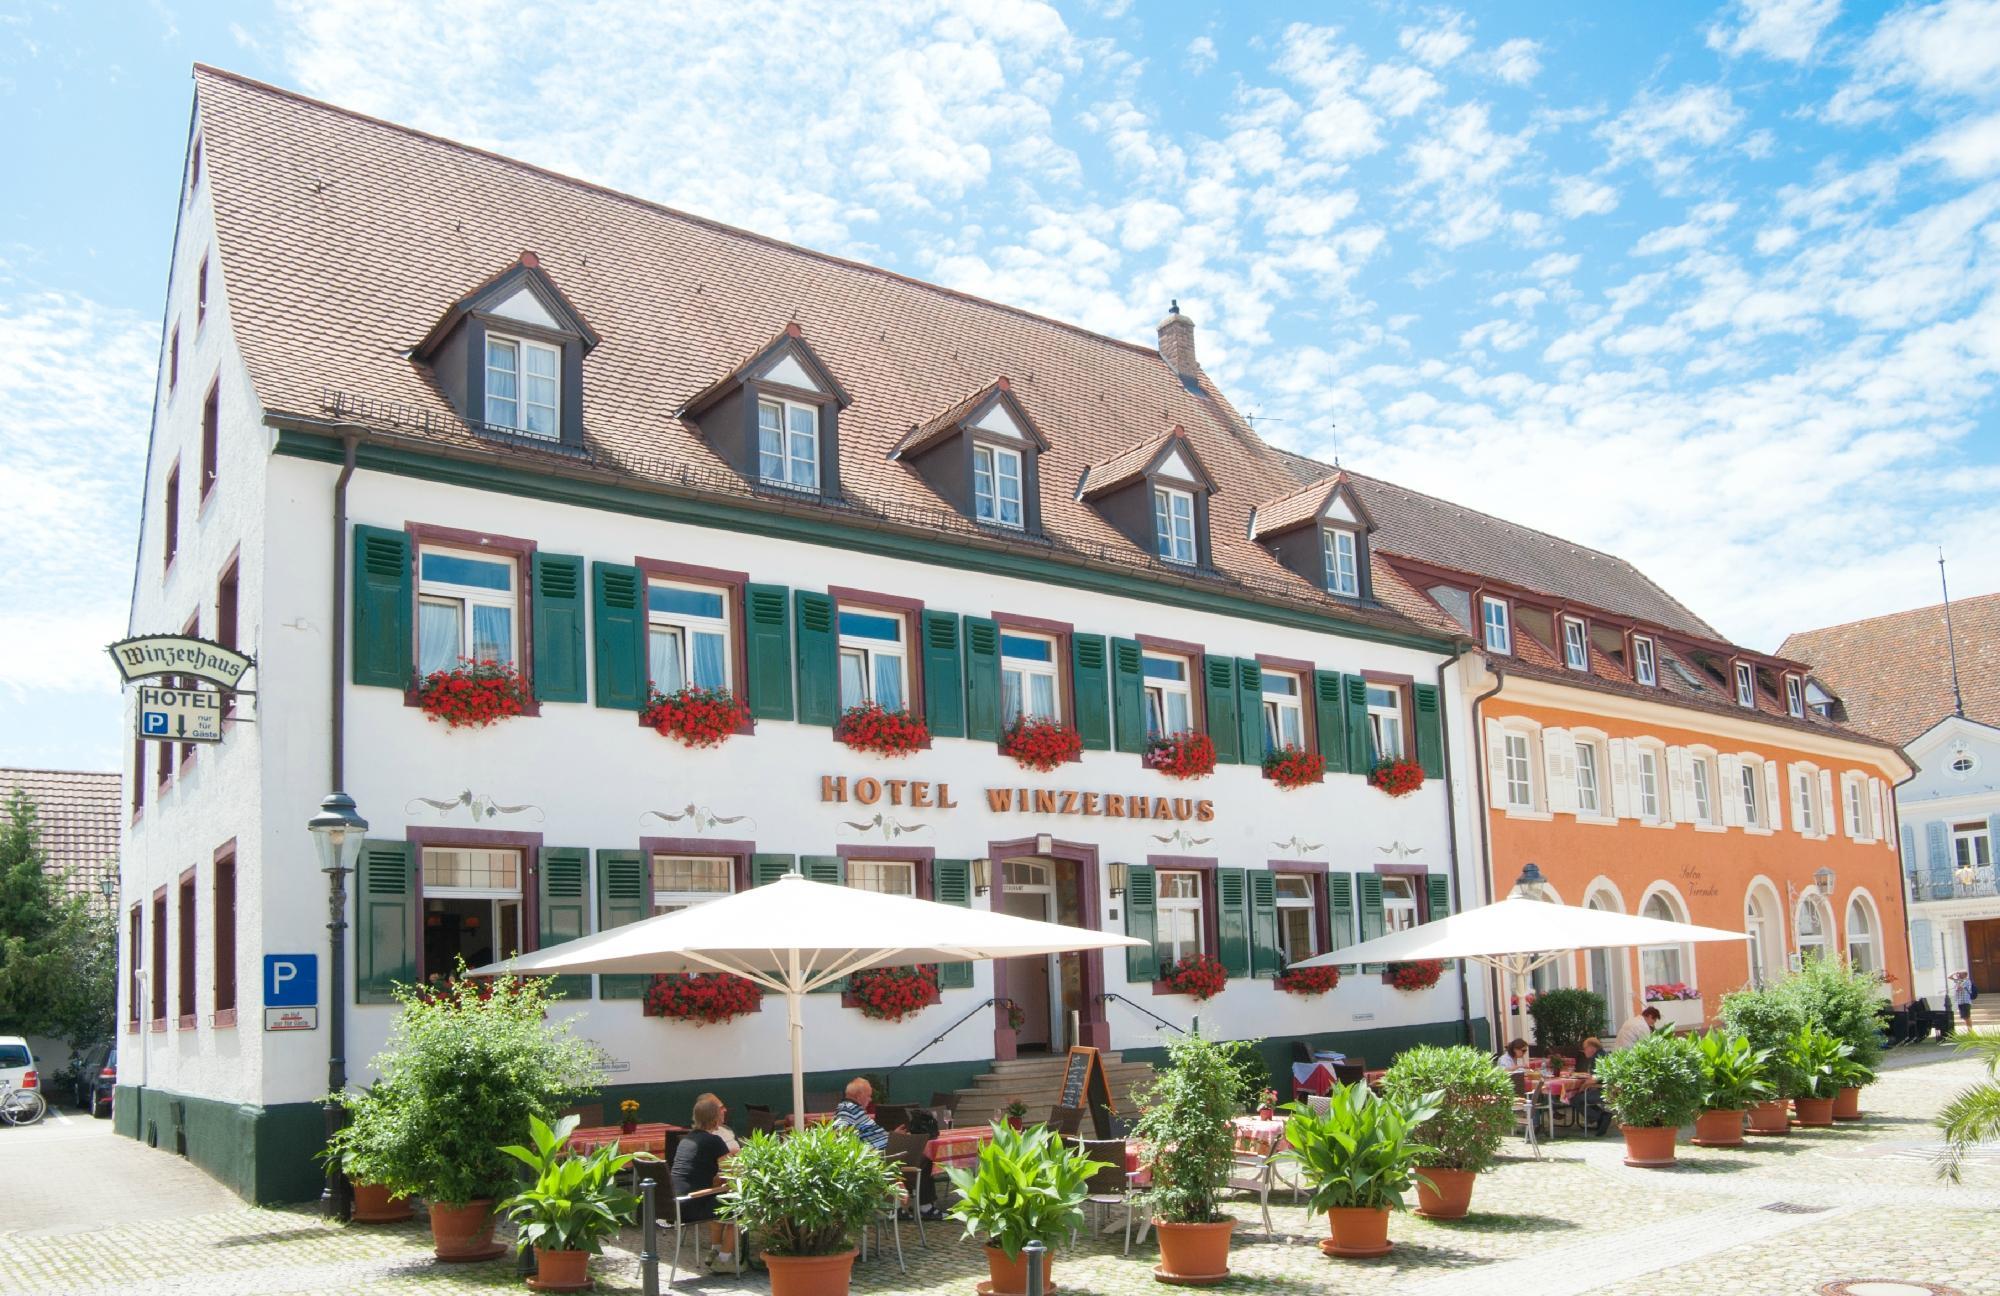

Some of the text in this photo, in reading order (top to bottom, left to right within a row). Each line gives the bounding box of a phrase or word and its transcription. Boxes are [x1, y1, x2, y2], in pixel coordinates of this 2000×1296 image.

[121, 645, 240, 677] Winzerhaus
[144, 690, 219, 709] HOTEL
[149, 714, 164, 732] P
[192, 730, 218, 738] Gäste
[820, 775, 1215, 822] HOTEL WINZERHAUS
[273, 961, 298, 995] P
